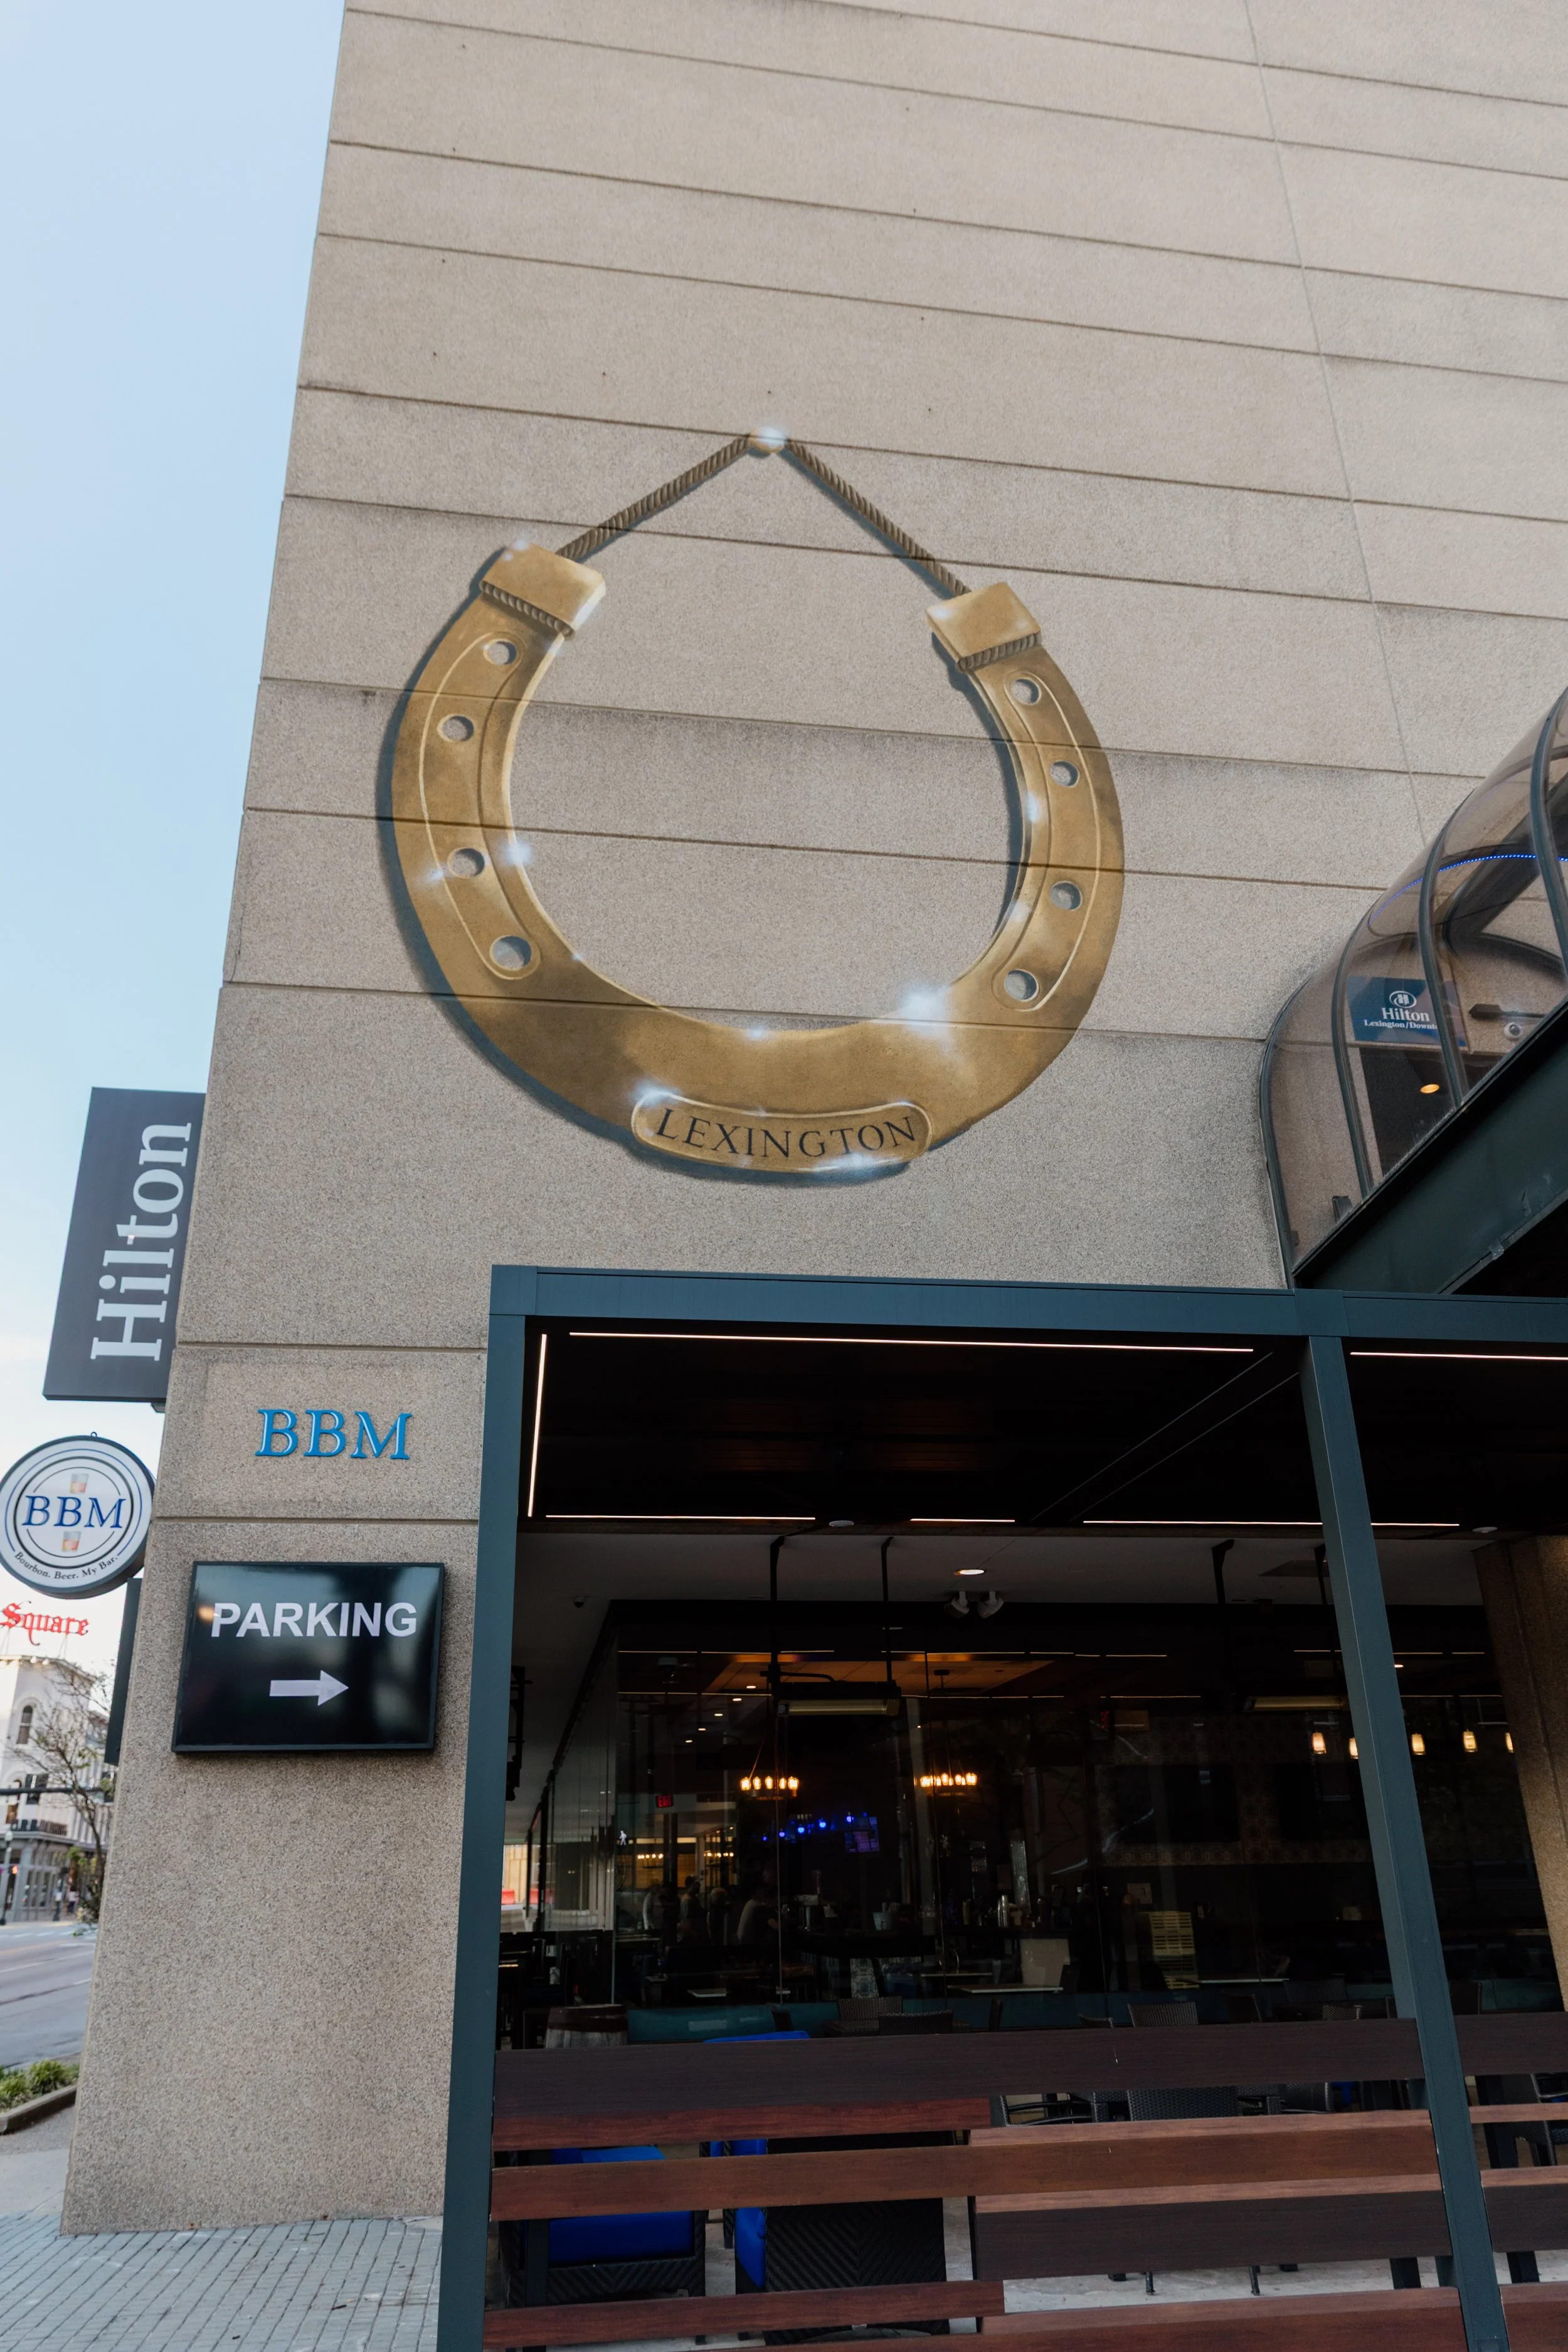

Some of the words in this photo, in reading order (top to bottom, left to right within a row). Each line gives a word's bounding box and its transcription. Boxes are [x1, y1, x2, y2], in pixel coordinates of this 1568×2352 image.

[1381, 1007, 1430, 1022] Hilton
[656, 1108, 916, 1158] LEXINGTON
[90, 1123, 192, 1361] Hilton
[254, 1409, 413, 1459] BBM
[21, 1495, 126, 1528] BBM
[14, 1551, 51, 1578] Bourbon.
[54, 1571, 78, 1580] Beer.
[82, 1568, 97, 1577] My
[98, 1557, 119, 1570] Bar.
[0, 1601, 89, 1646] Square
[211, 1602, 417, 1638] PARKING
